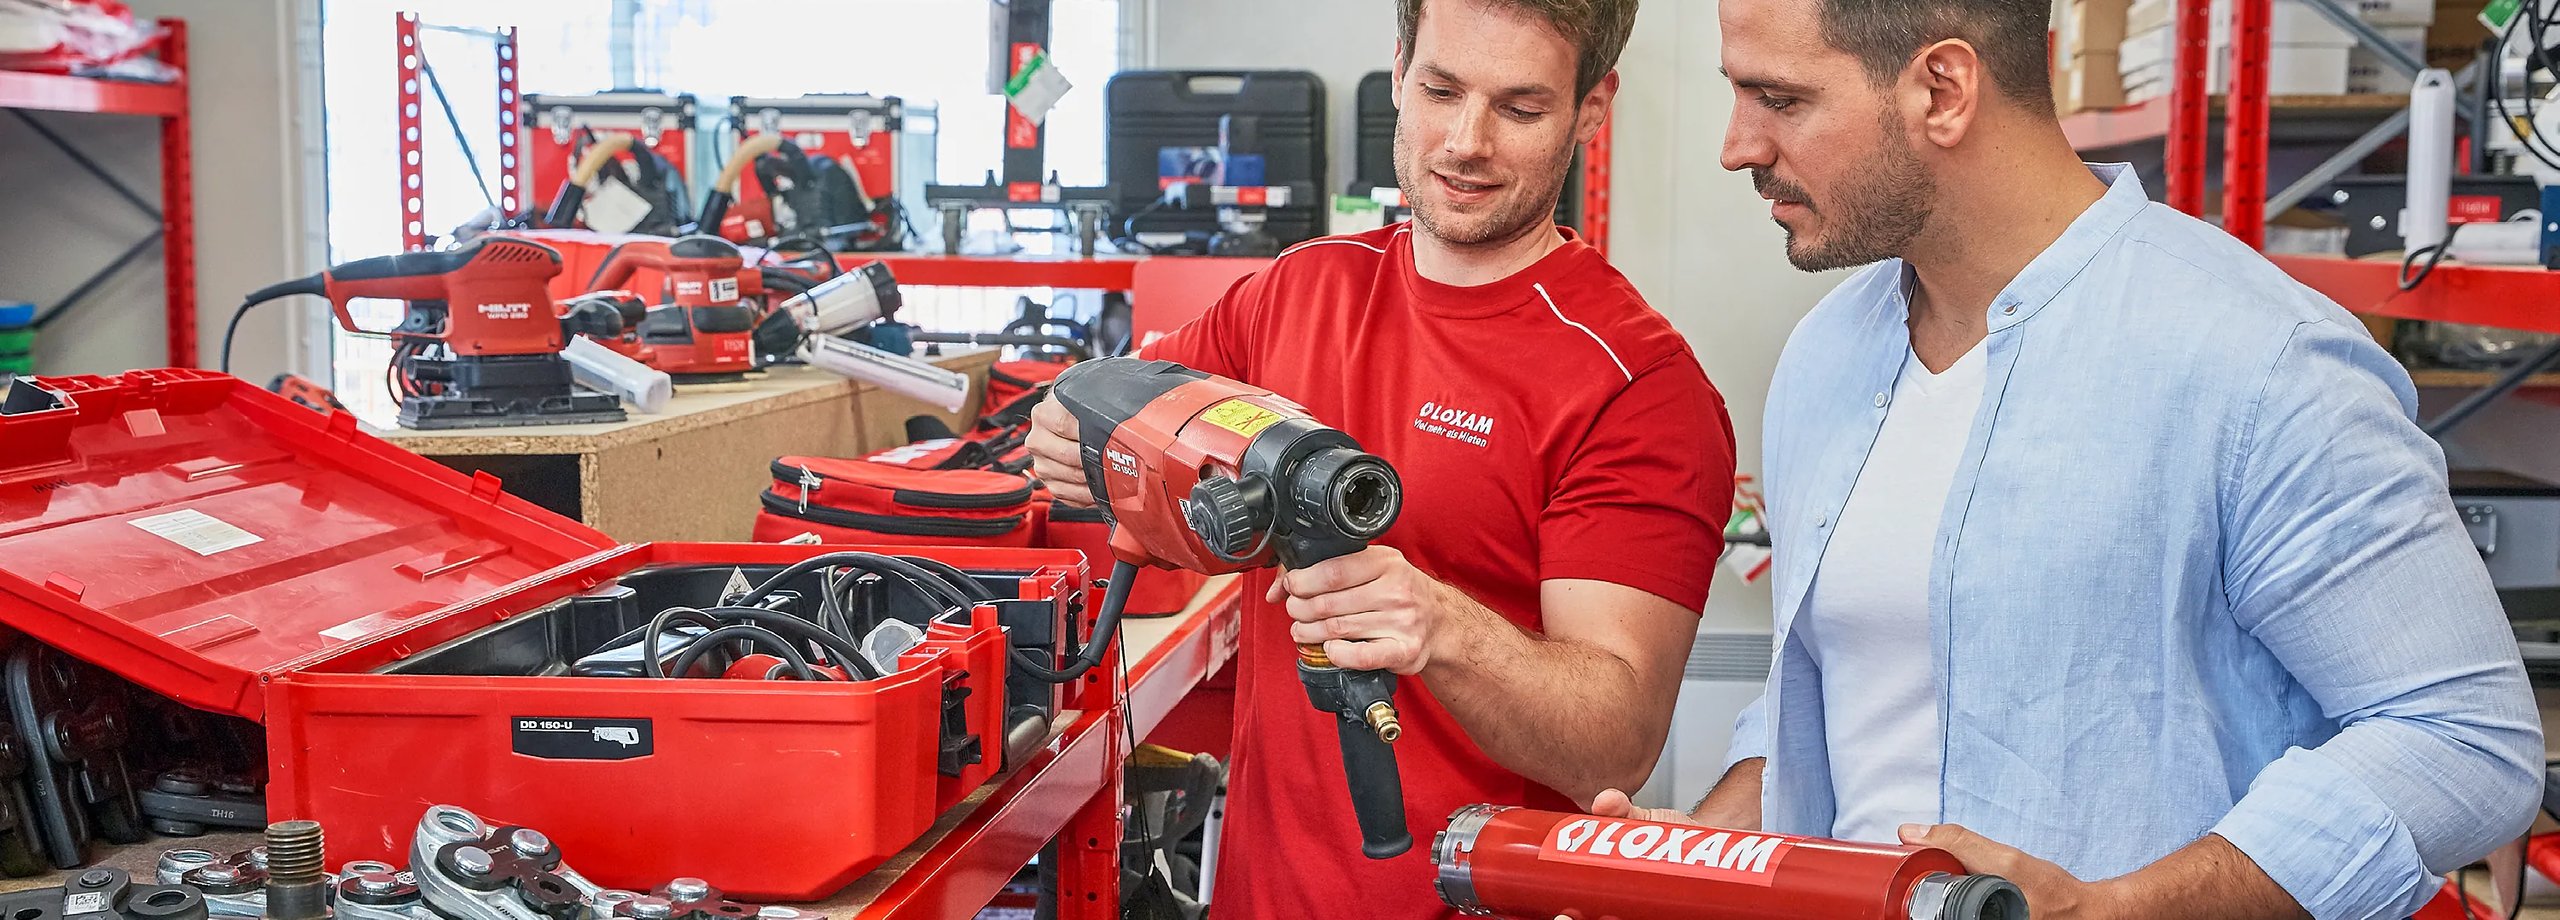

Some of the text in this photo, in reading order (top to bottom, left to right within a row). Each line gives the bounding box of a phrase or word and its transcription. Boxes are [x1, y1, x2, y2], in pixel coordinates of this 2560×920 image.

[1413, 418, 1487, 447] Viel mehr als Mieten
[1106, 447, 1136, 468] HILTI
[520, 720, 573, 729] DD 150-U
[211, 808, 234, 819] TH16
